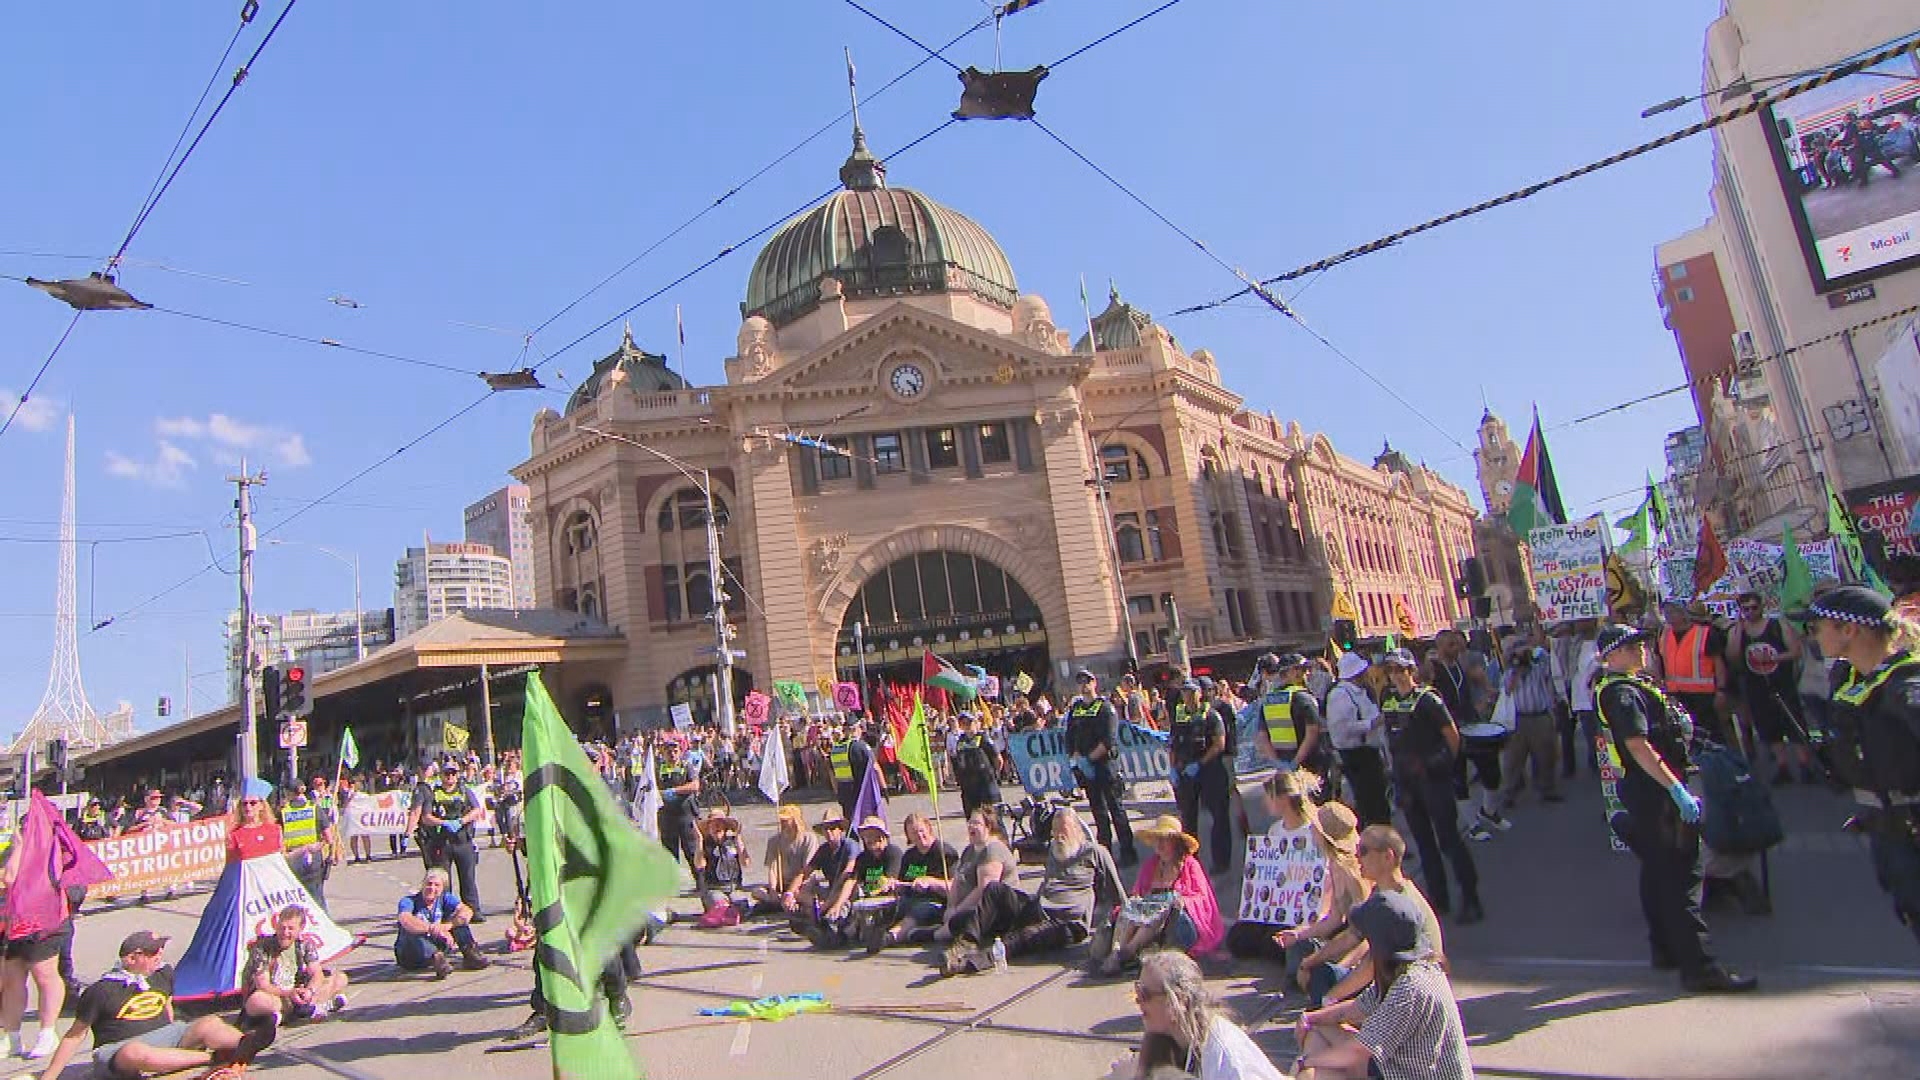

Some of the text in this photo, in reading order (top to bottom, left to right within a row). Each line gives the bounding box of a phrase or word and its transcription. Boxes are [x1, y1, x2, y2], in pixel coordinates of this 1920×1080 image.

[1870, 231, 1910, 251] Mobil
[1869, 492, 1905, 510] THE
[1857, 508, 1912, 533] COLON
[1883, 543, 1920, 560] FAL
[1029, 761, 1064, 789] OR
[360, 811, 406, 828] CLIMA
[89, 820, 226, 863] ISRUPTION
[1257, 865, 1279, 881] THE
[246, 887, 306, 916] CLIMATE
[1269, 886, 1305, 910] LOVE
